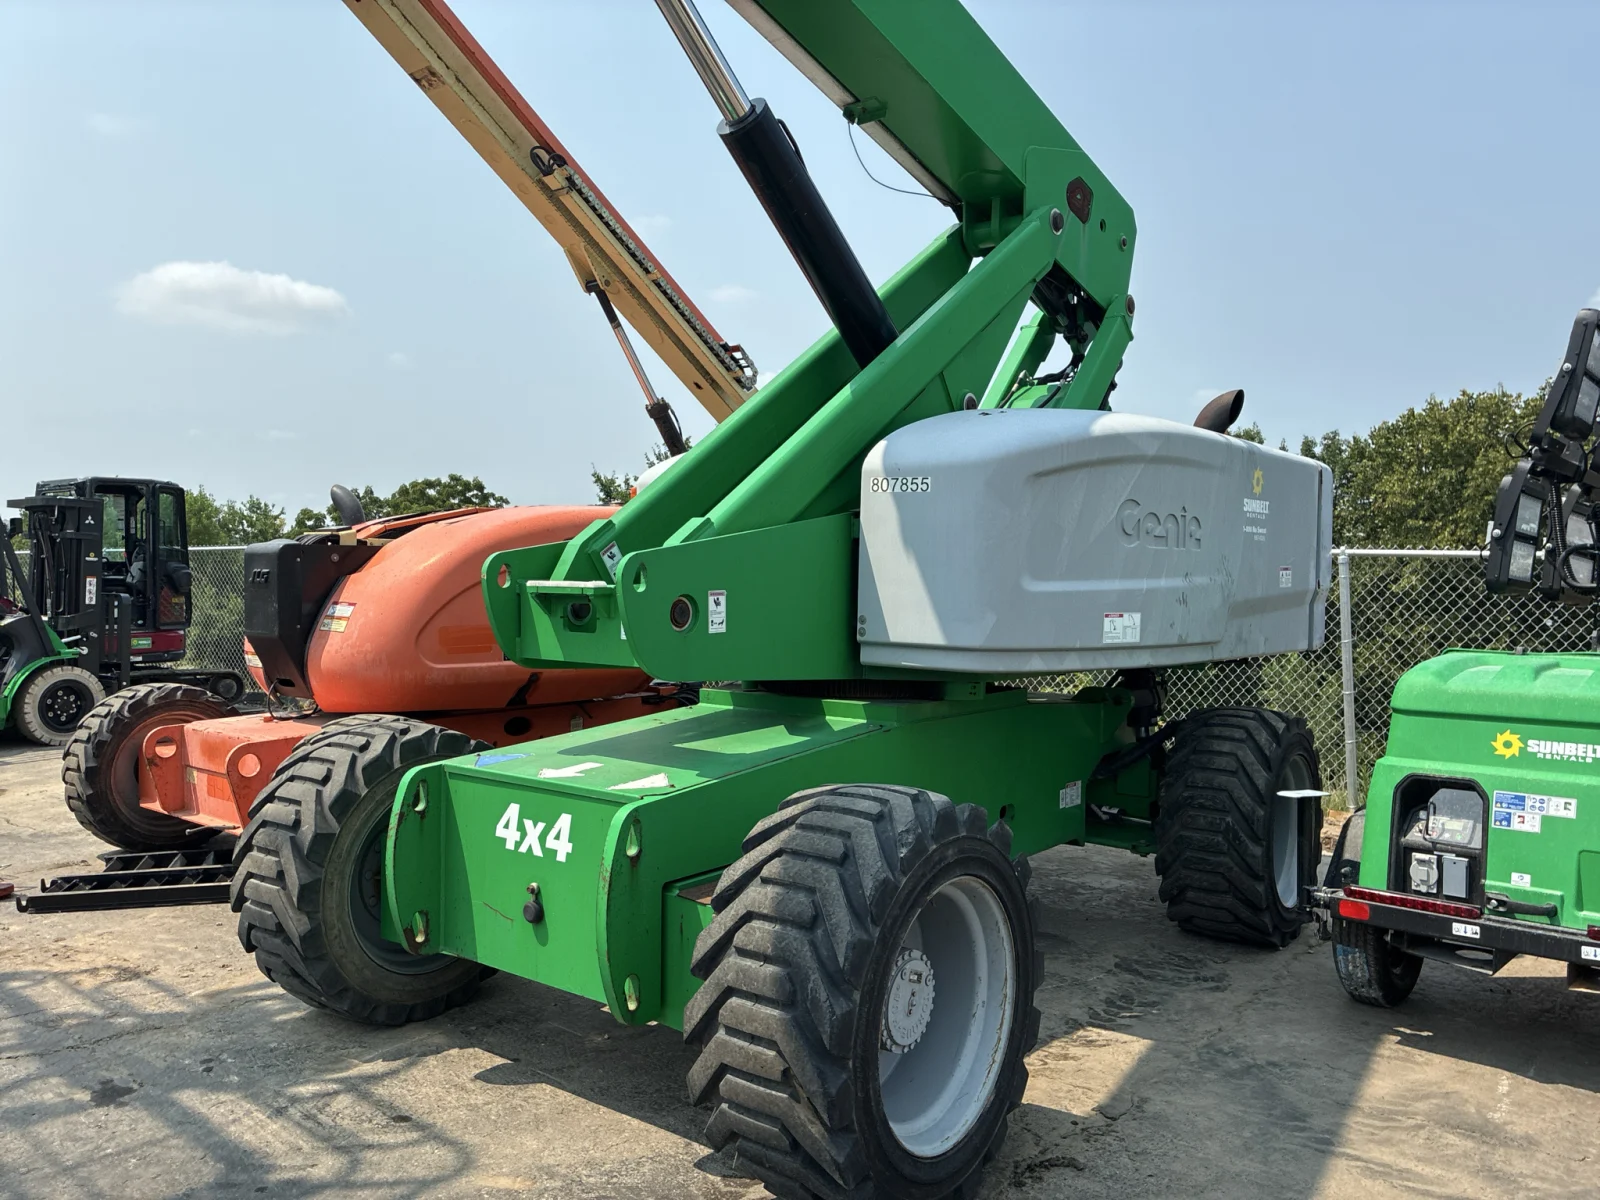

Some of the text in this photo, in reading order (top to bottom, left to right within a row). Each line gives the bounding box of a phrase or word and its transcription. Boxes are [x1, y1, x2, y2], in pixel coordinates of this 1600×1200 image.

[871, 477, 930, 493] 807855
[1243, 498, 1270, 514] SUNBELT
[1246, 512, 1266, 520] RENTALS
[1116, 498, 1201, 551] Genie
[1537, 753, 1593, 763] RENTALS
[495, 802, 573, 863] 4x4
